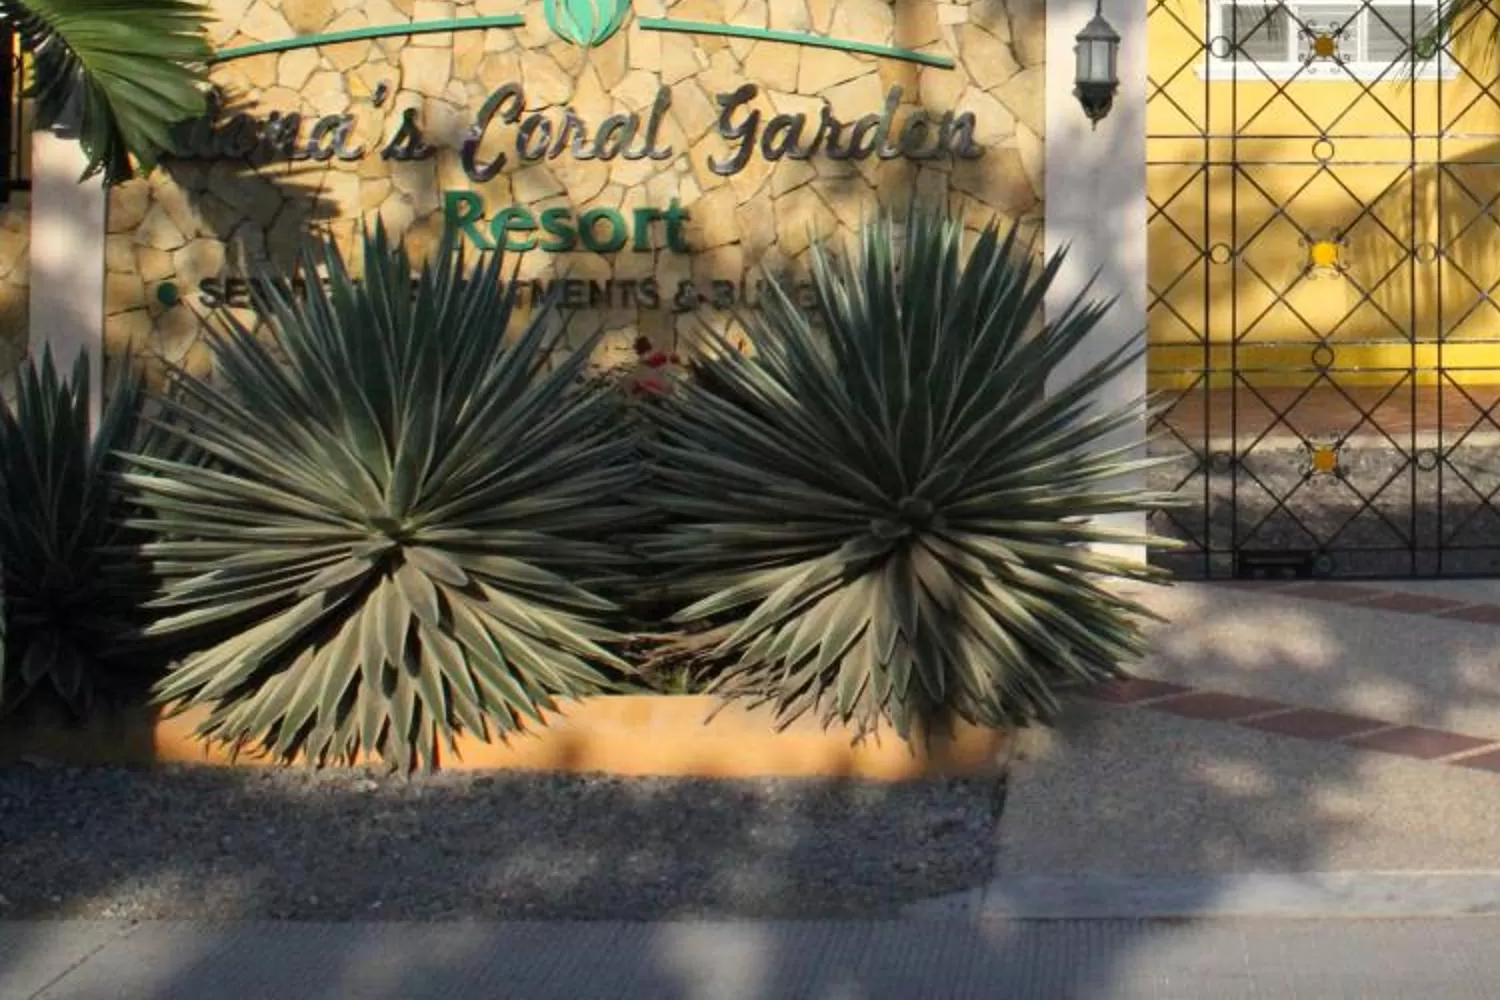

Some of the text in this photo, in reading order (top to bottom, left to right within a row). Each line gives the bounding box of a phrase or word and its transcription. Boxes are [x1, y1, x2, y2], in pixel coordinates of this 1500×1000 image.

[460, 81, 673, 183] Coral
[706, 82, 985, 177] Garden
[443, 188, 690, 254] Resort
[674, 278, 701, 313] &
